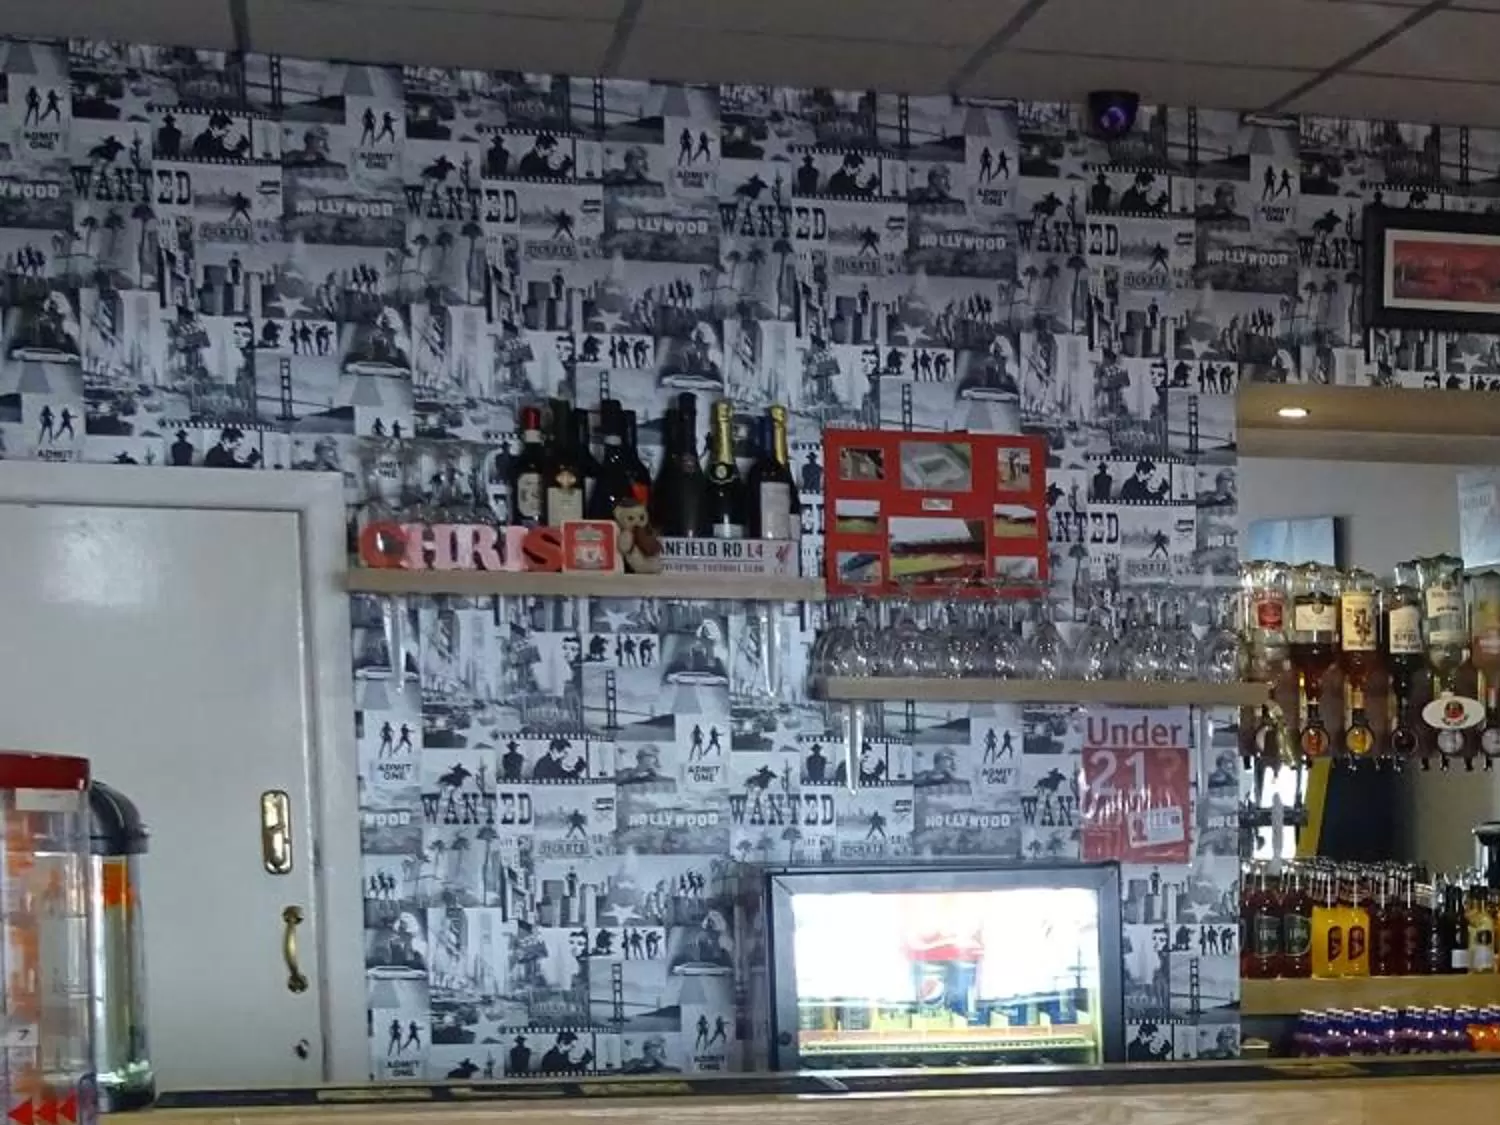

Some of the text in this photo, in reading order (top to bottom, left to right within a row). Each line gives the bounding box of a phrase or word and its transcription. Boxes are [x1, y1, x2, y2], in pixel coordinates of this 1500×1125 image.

[0, 181, 60, 199] YWOOD
[70, 165, 191, 204] WANTED
[296, 198, 394, 217] HOLLYWOOD
[403, 185, 517, 223] WANTED
[617, 213, 708, 235] HOLLYWOOD
[719, 203, 827, 240] WANTED
[919, 232, 1008, 250] HOLLYWOOD
[1017, 220, 1119, 256] WANTED
[1298, 236, 1362, 269] WANT
[1206, 247, 1290, 266] HOLLYWOOD
[1047, 511, 1119, 543] NTED
[361, 521, 563, 572] CHRIS
[723, 543, 742, 558] RD
[747, 543, 765, 558] L4
[1087, 716, 1183, 746] Under
[1089, 750, 1146, 797] 21
[420, 793, 532, 825] WANTED
[730, 793, 835, 826] WANTED
[924, 811, 1010, 829] HOLLYWOOD
[1020, 795, 1081, 826] WAN
